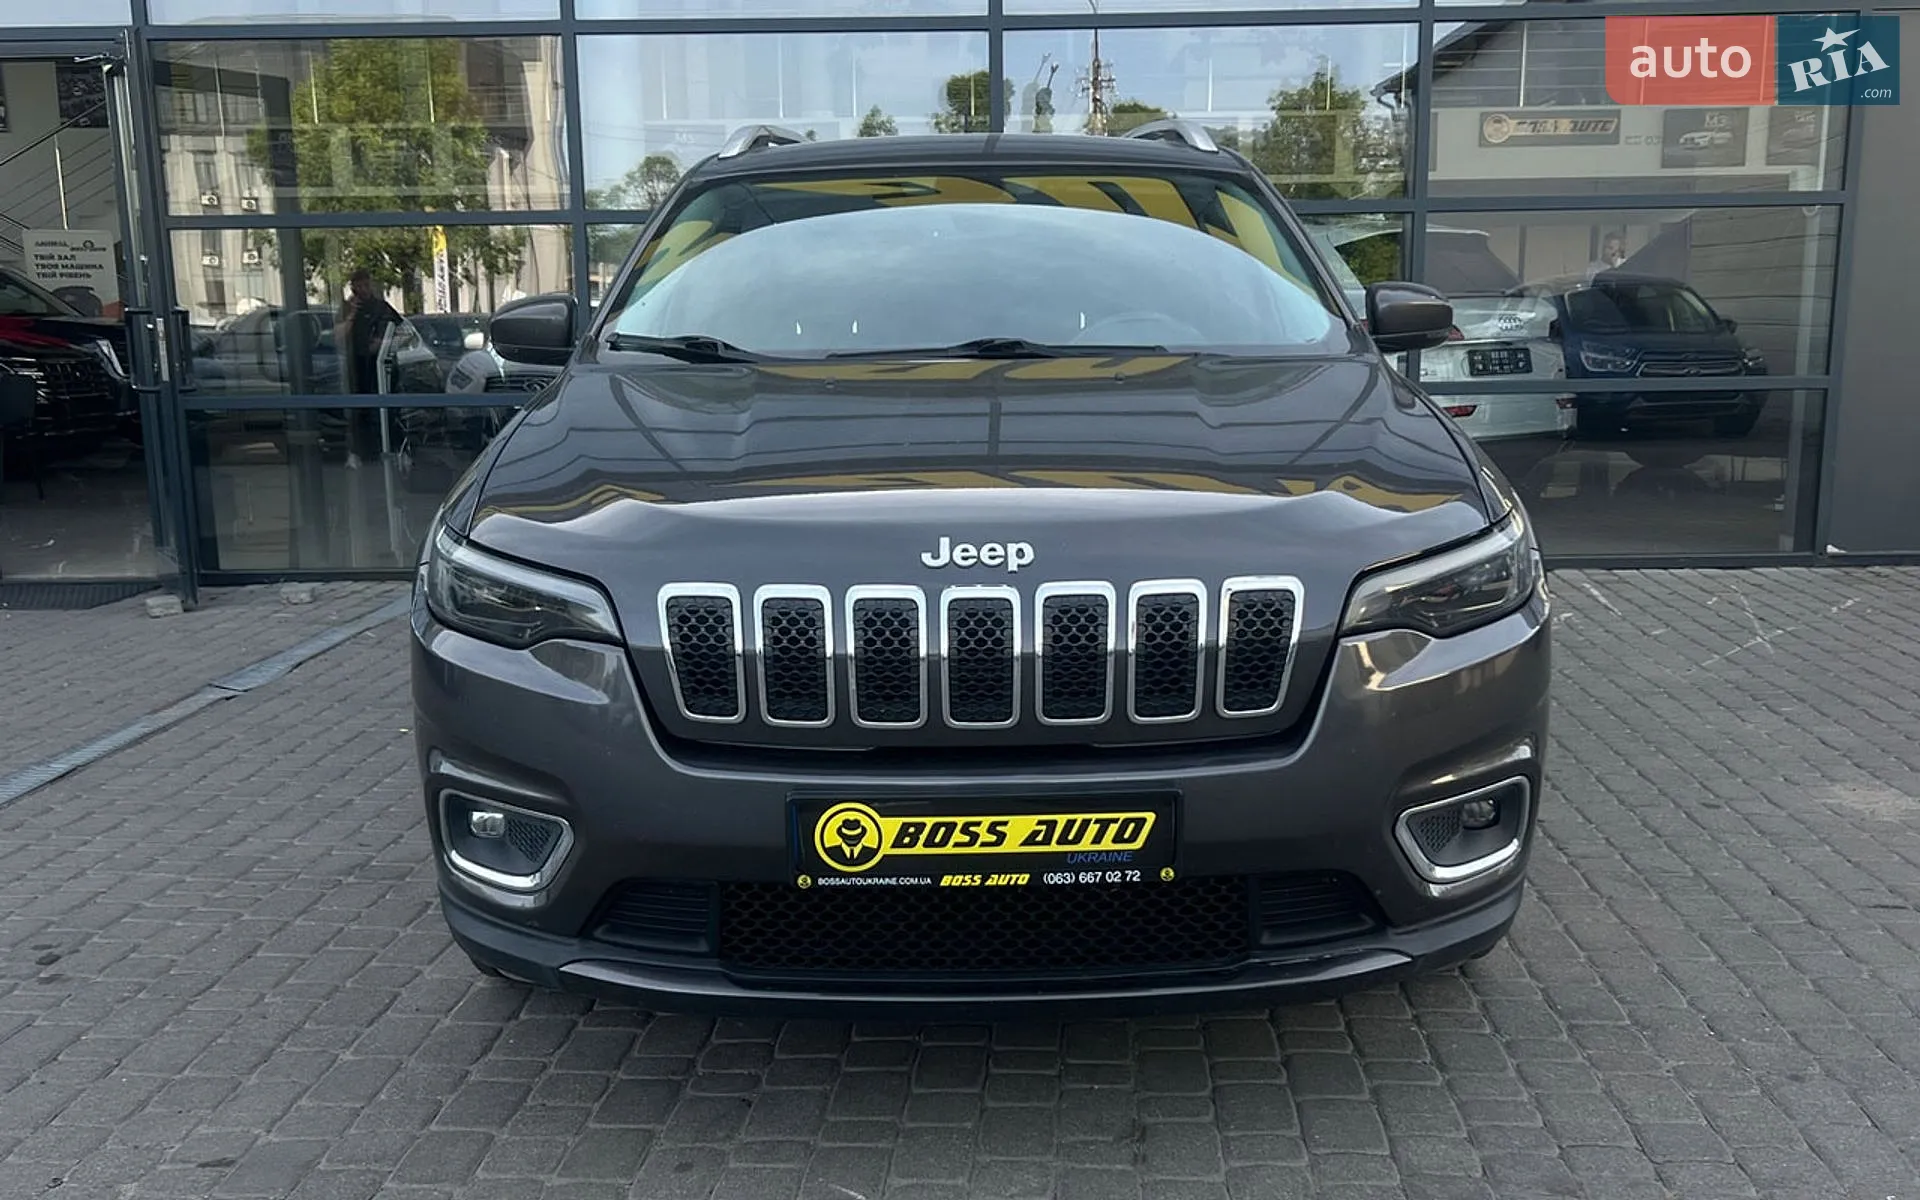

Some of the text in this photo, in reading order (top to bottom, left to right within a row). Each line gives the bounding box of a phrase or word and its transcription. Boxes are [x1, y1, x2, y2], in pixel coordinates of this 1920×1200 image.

[921, 536, 1035, 573] Jeep
[890, 817, 1148, 849] BOSS AUTO
[1066, 850, 1134, 864] UKRAINE
[939, 873, 1031, 887] BOSS AUTO
[1042, 870, 1142, 885] (063) 667 02 72
